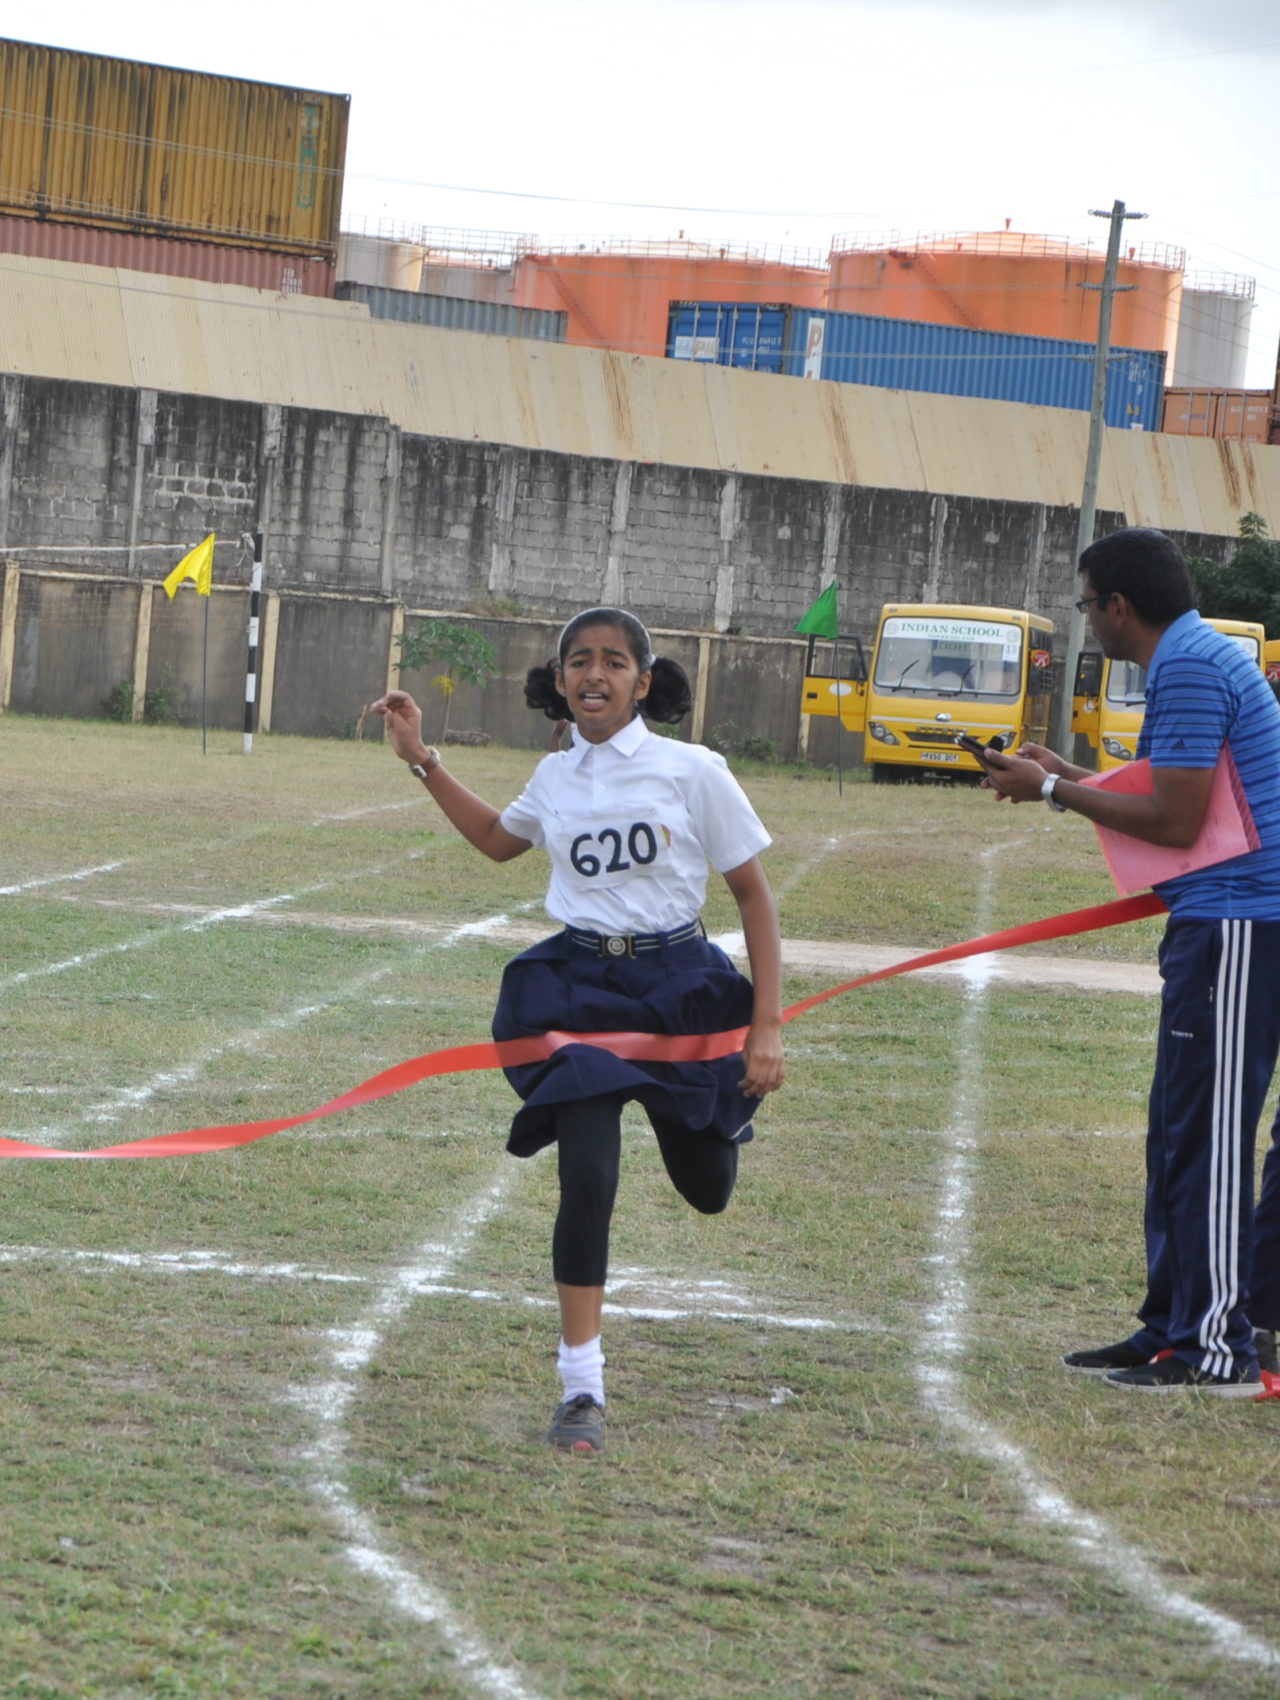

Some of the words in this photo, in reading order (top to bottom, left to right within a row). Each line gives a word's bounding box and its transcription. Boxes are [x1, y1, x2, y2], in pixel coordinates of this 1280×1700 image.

[901, 623, 949, 634] INDIAN
[951, 626, 1004, 638] SCHOOL
[570, 821, 658, 877] 620
